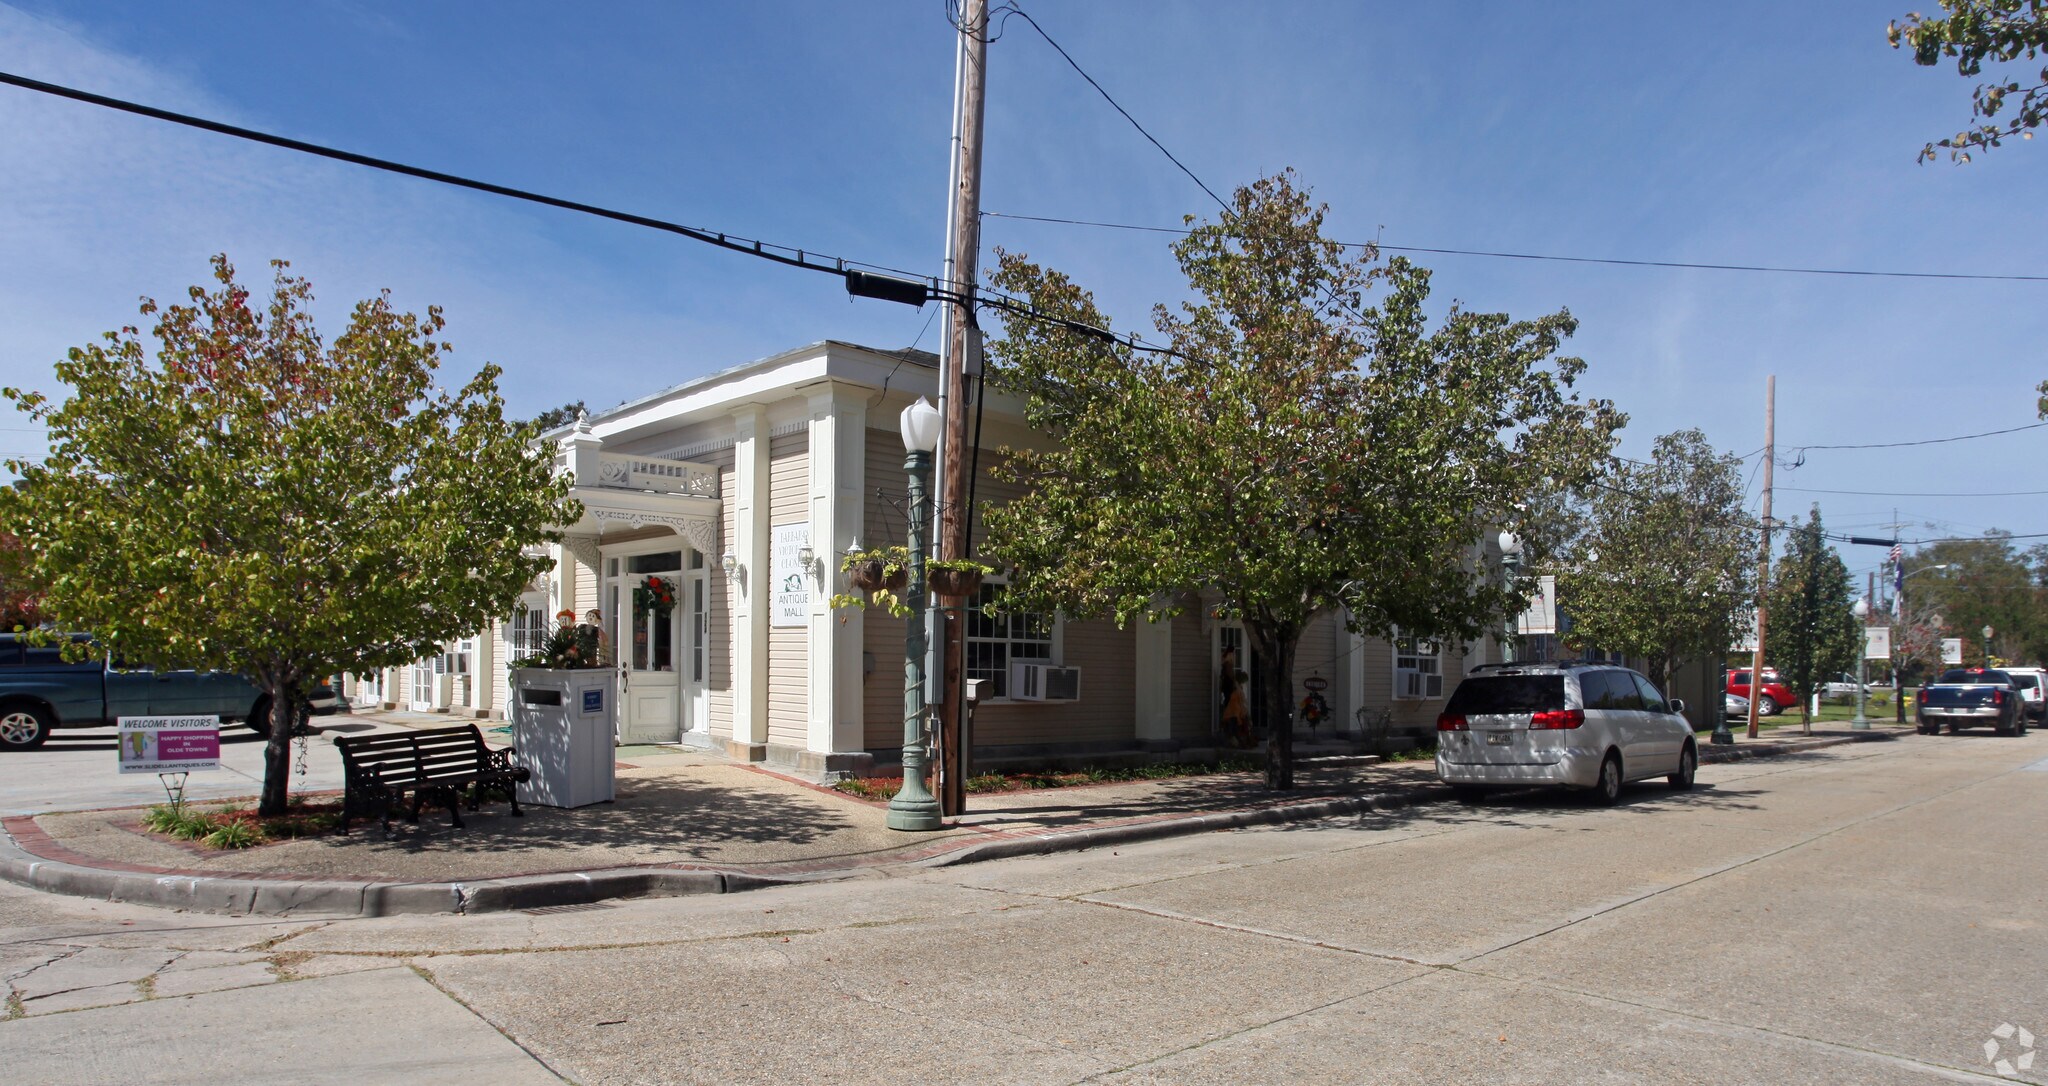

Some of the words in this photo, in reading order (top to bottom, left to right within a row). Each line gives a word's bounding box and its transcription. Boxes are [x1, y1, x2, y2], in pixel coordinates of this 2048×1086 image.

[779, 594, 808, 605] ANTIQUE
[784, 608, 804, 617] MALL
[124, 719, 168, 729] WELCOME
[171, 718, 212, 728] VISITORS
